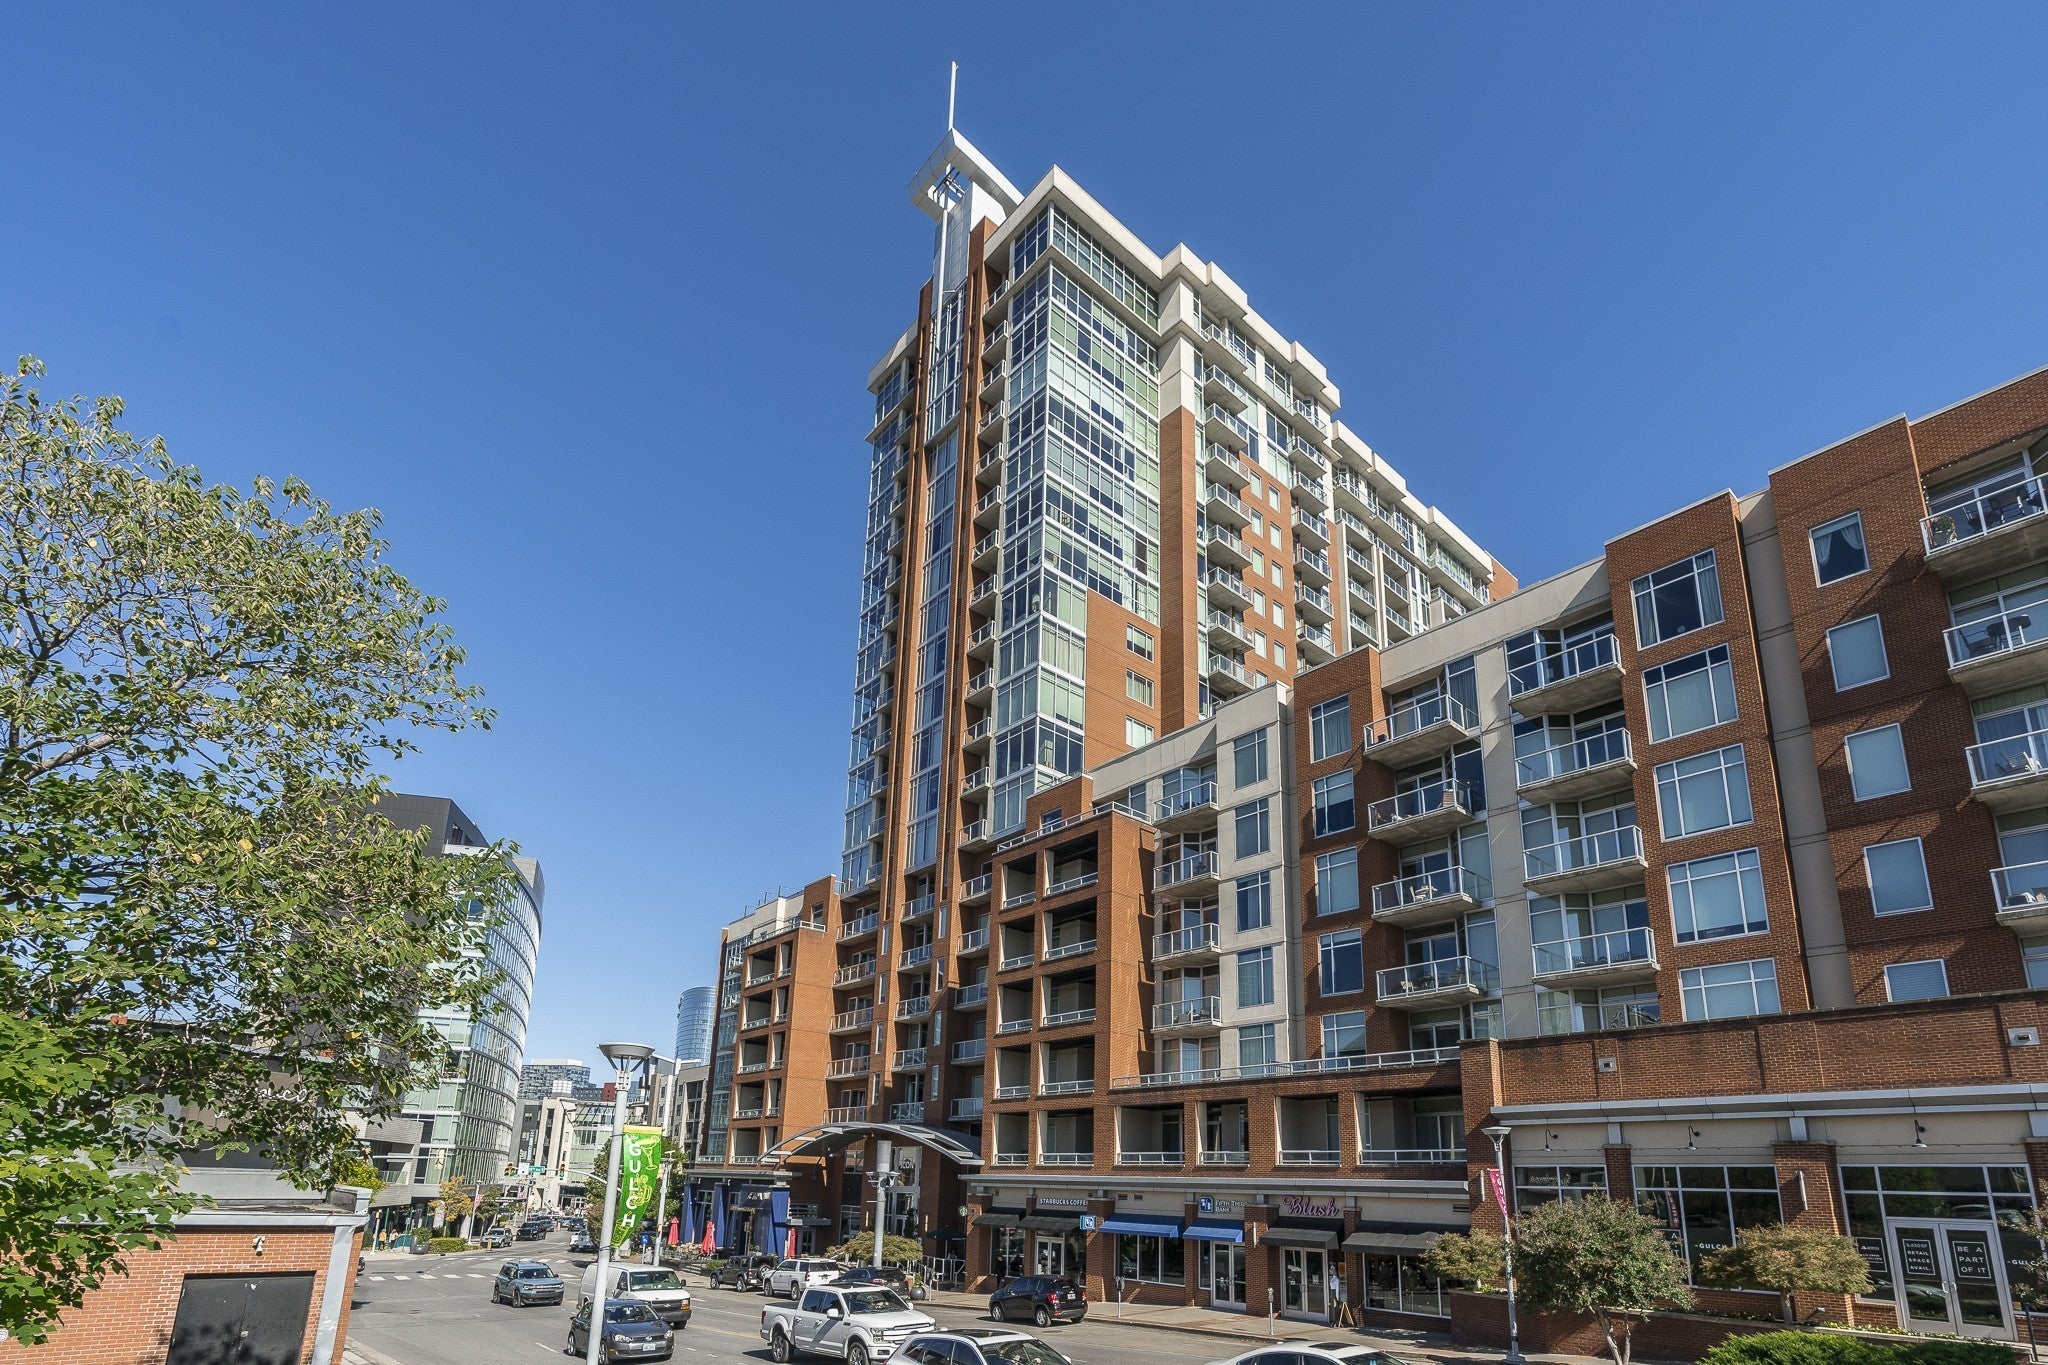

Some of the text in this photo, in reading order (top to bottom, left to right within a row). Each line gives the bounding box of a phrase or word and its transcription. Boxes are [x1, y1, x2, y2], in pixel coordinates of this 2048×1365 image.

[901, 1161, 914, 1169] ICON
[622, 1143, 642, 1228] GULCH
[1283, 1195, 1339, 1216] Blush
